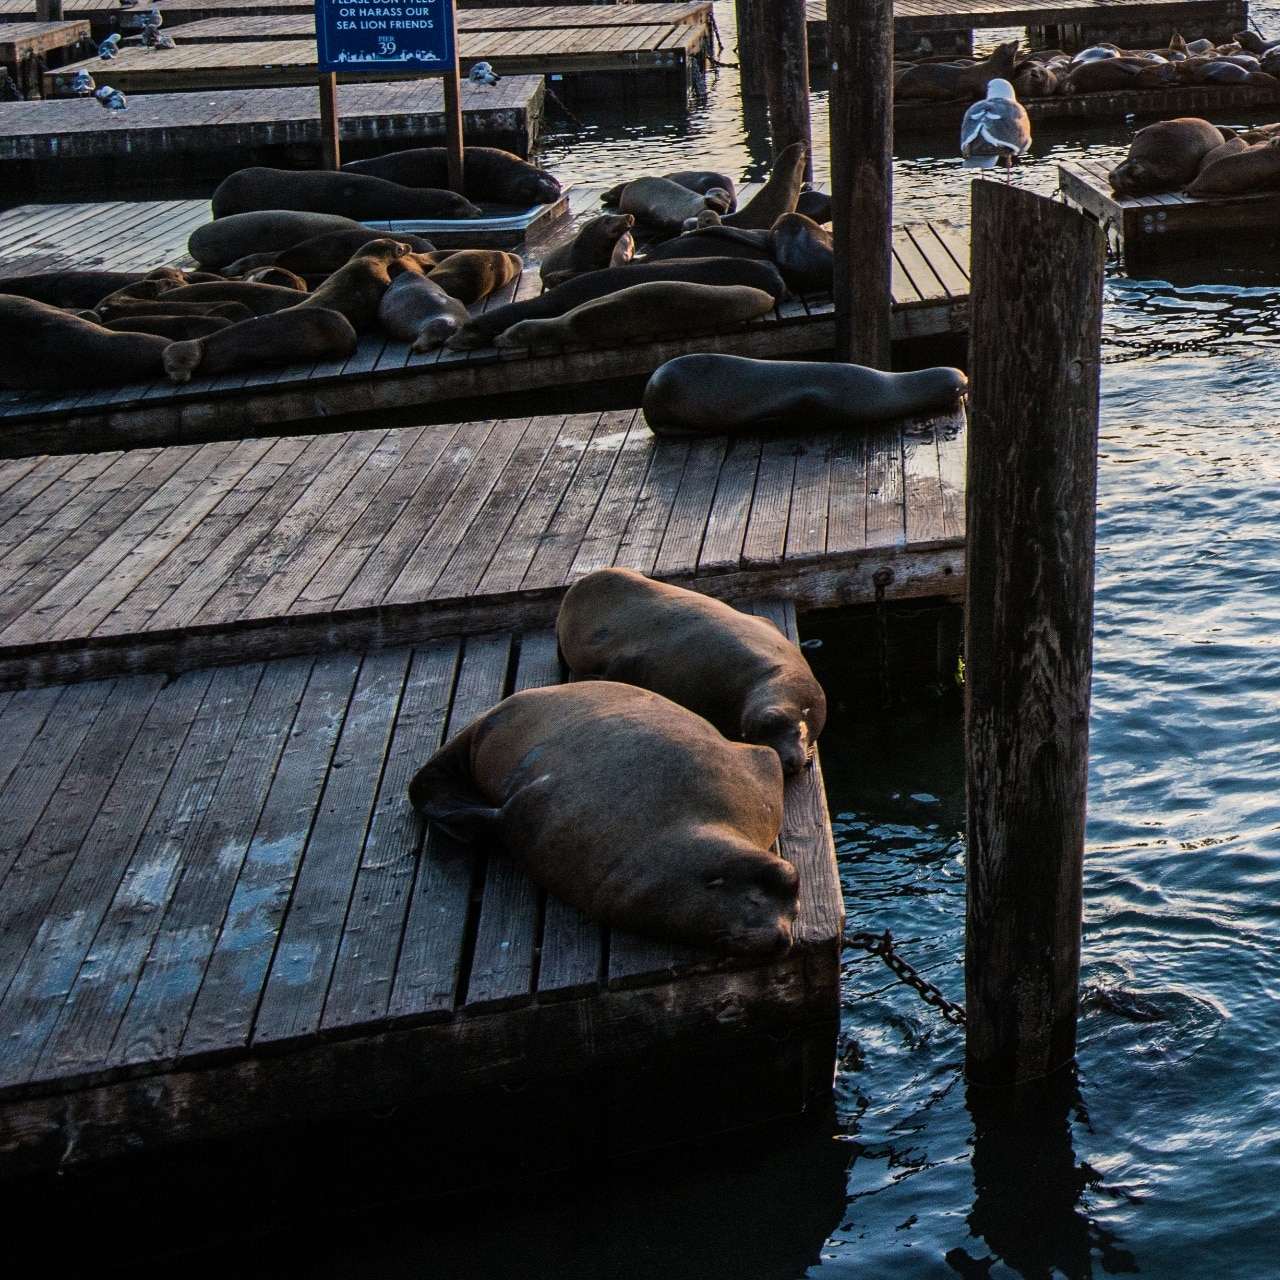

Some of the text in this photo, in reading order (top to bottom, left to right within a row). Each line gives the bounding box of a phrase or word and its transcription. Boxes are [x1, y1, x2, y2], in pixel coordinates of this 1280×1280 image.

[339, 6, 430, 17] OR HARASS OUR
[336, 19, 434, 30] SEA LION FRIENDS
[378, 41, 397, 55] 39
